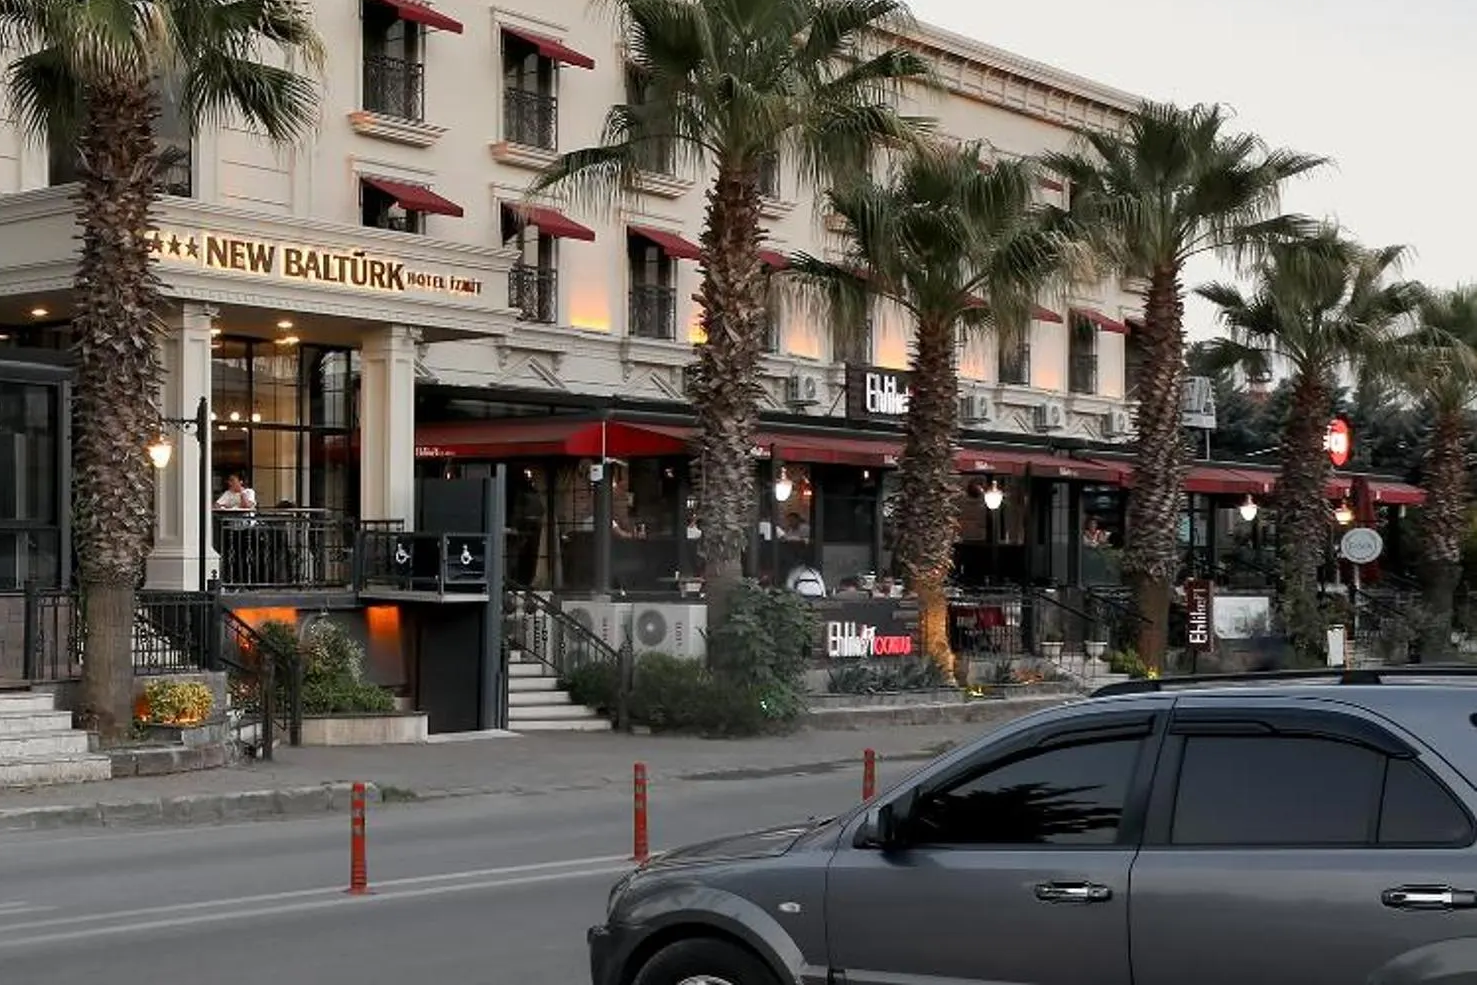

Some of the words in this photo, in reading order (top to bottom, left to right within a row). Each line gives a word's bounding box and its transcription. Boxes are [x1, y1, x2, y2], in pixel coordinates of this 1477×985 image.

[206, 235, 275, 274] NEW
[283, 247, 406, 291] BALTÜRK
[406, 271, 445, 289] HOTEL
